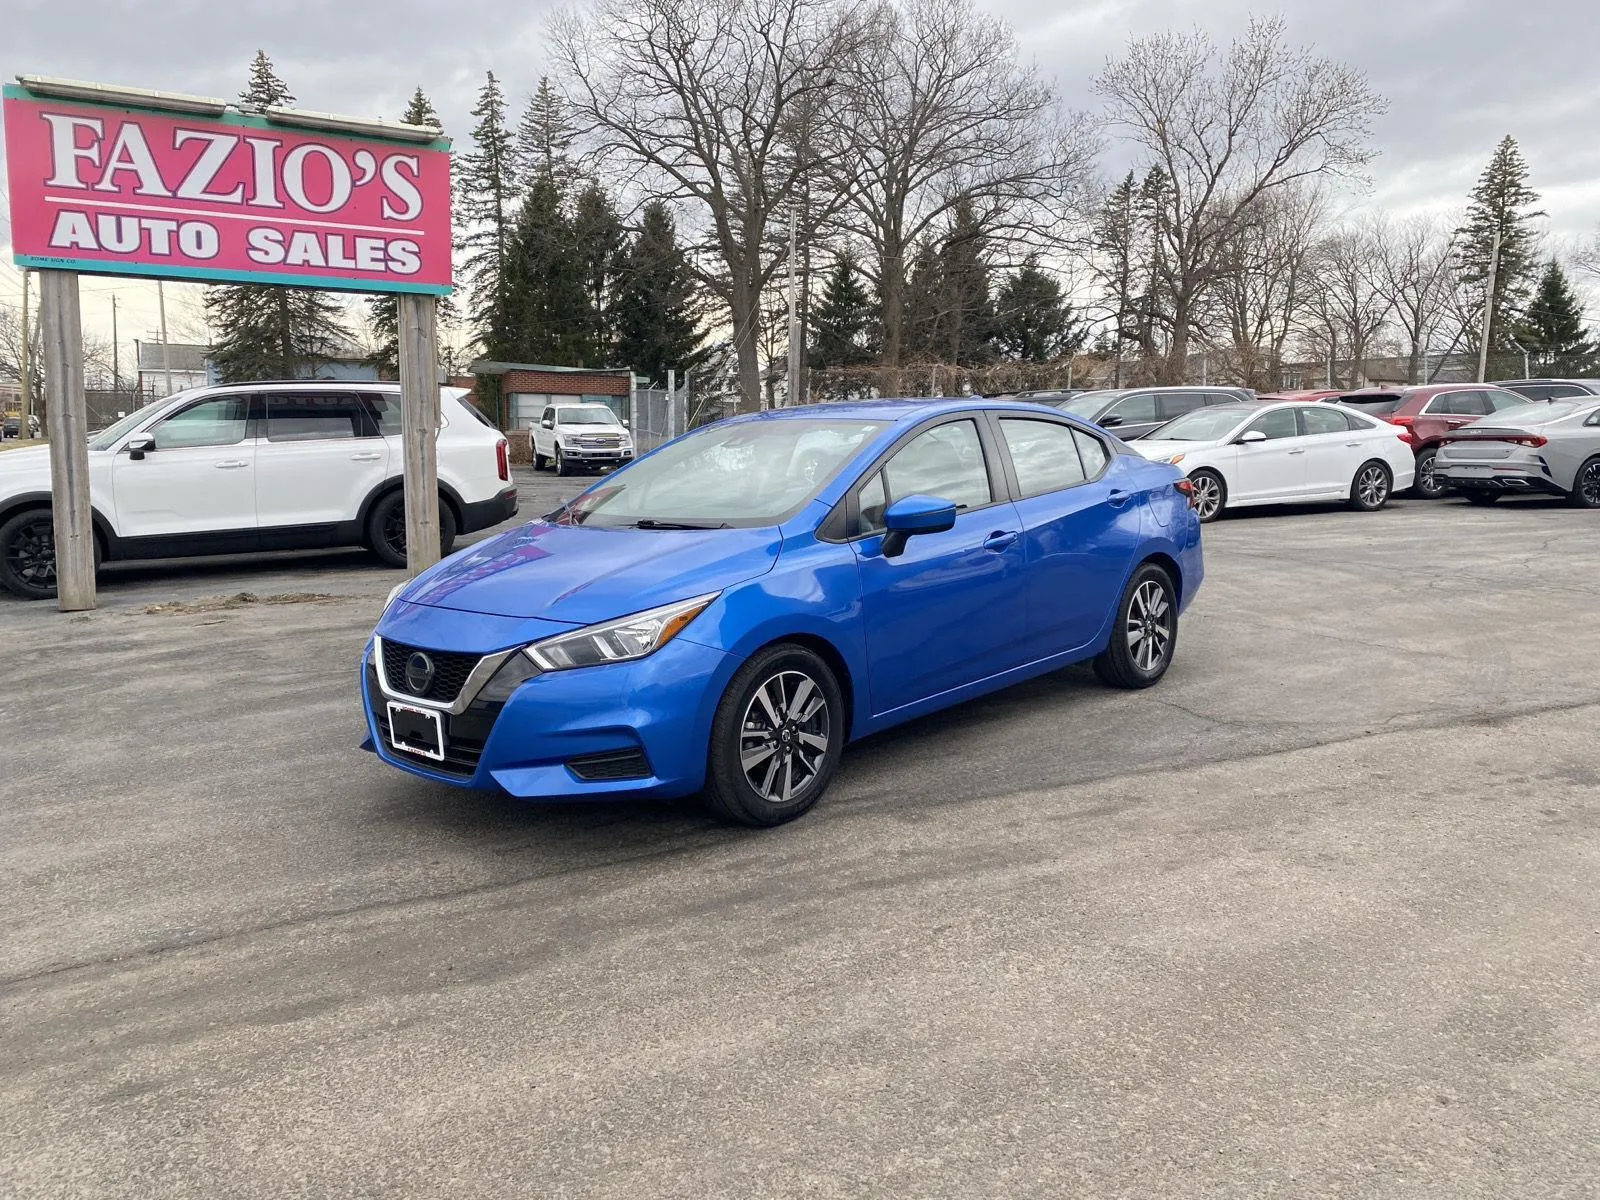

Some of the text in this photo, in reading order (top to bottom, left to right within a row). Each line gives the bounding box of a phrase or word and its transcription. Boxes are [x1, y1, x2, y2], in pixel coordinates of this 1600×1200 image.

[40, 111, 424, 222] FAZIO'S
[48, 209, 422, 275] AUTO SALES
